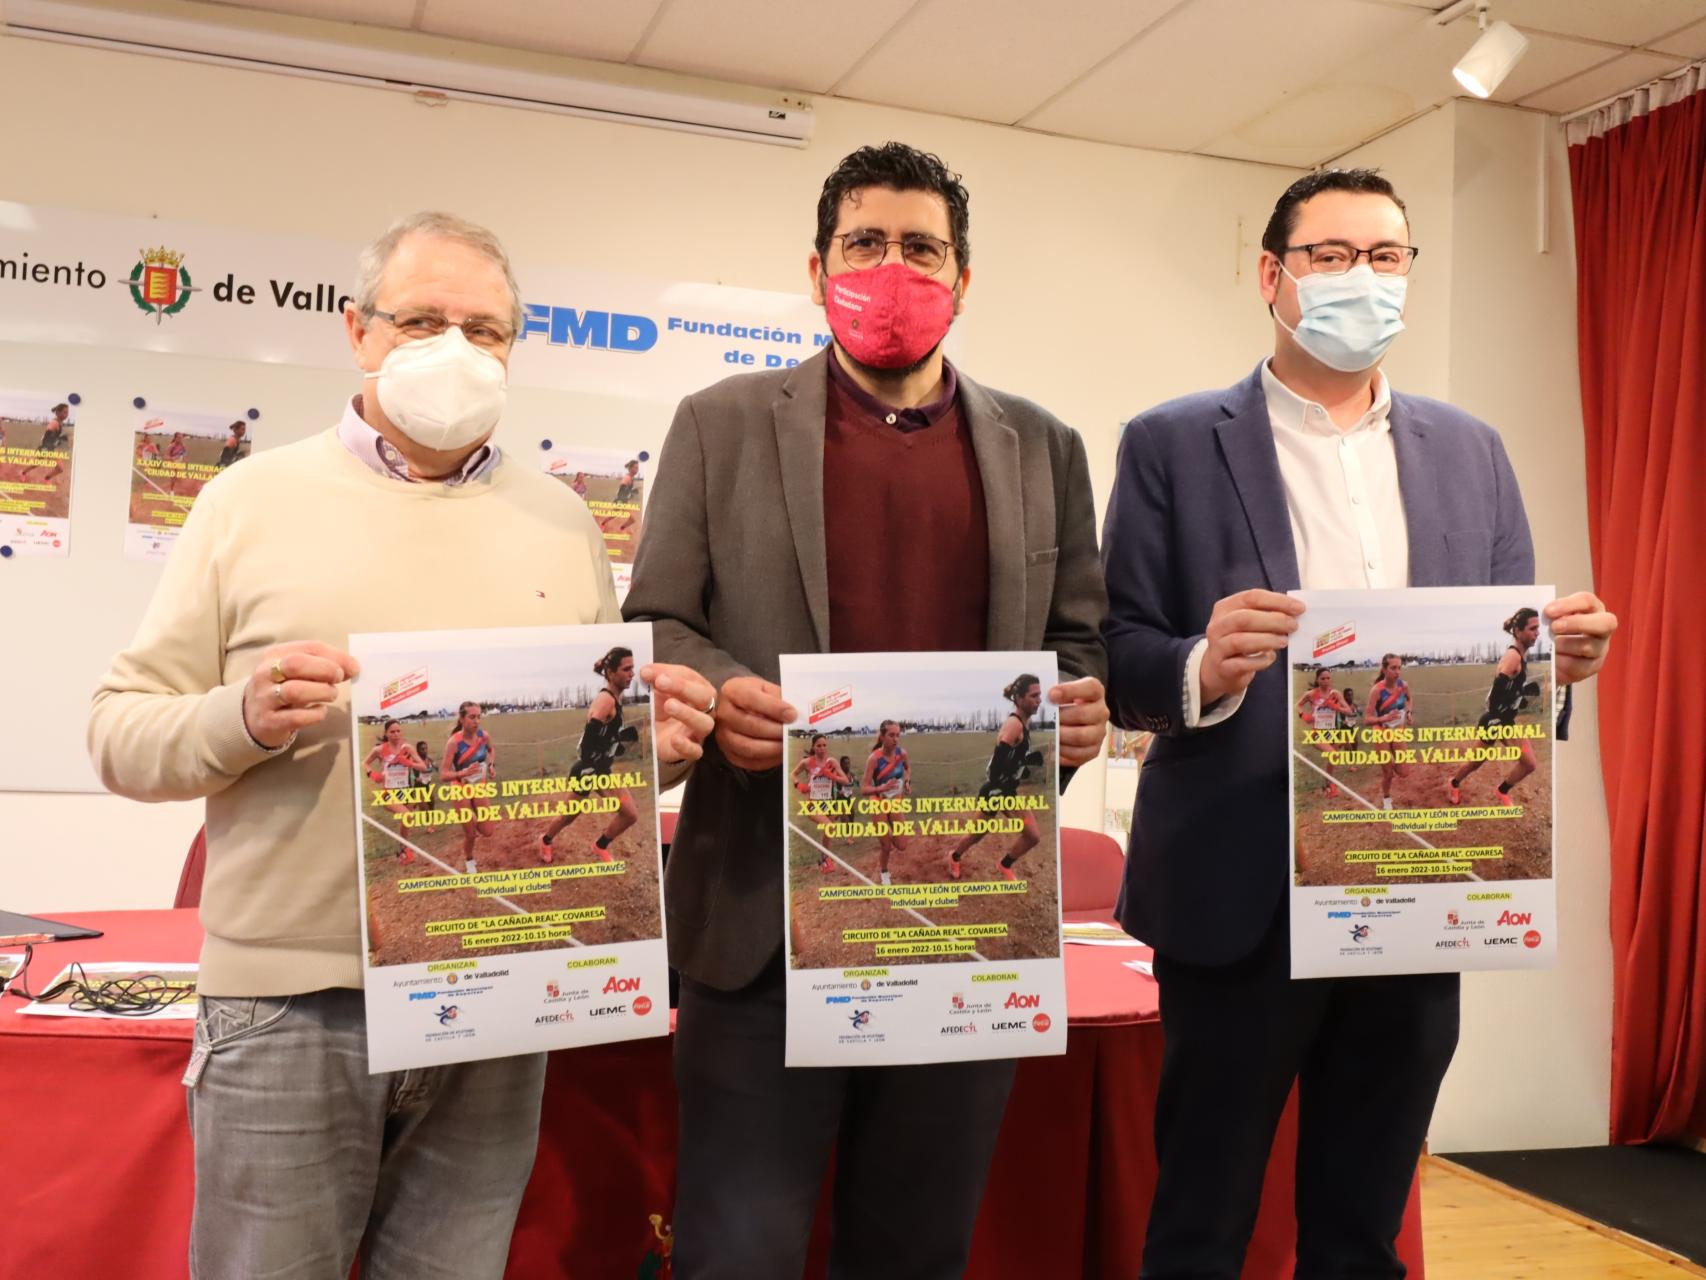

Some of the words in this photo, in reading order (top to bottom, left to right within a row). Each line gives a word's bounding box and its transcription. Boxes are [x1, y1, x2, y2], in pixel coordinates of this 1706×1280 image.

[213, 273, 256, 305] de
[667, 316, 802, 345] Fundación
[723, 350, 755, 366] de
[1302, 727, 1359, 744] XXXIV
[1361, 728, 1414, 743] CROSS
[1418, 724, 1546, 742] INTERNACIONAL
[1395, 749, 1417, 764] DE
[1420, 746, 1521, 763] VALLADOLID
[371, 784, 436, 806] XXXIV
[438, 782, 498, 801] CROSS
[502, 772, 647, 796] INTERNACIONAL
[477, 805, 502, 822] DE
[506, 797, 620, 820] VALLADOLID
[797, 797, 856, 816] XXXIV
[858, 798, 912, 814] CROSS
[916, 795, 1049, 813] INTERNACIONAL
[1323, 813, 1375, 821] CAMPEONATO
[1389, 812, 1421, 820] CASTILLA
[1430, 809, 1448, 818] LEÓN
[1461, 809, 1488, 817] CAMPO
[1497, 807, 1524, 815] TRAVÉS
[892, 820, 915, 836] DE
[919, 817, 1024, 835] VALLADOLID
[1435, 821, 1457, 829] clubes
[1408, 850, 1440, 859] CAÑADA
[1466, 849, 1504, 857] COVARESA
[1452, 864, 1472, 872] horas
[399, 879, 458, 890] CAMPEONATO
[460, 877, 472, 885] DE
[474, 874, 510, 884] CASTILLA
[520, 870, 540, 880] LEÓN
[543, 870, 553, 878] DE
[556, 867, 586, 877] CAMPO
[596, 863, 625, 873] TRAVÉS
[526, 882, 551, 891] clubes
[820, 889, 873, 897] CAMPEONATO
[876, 888, 886, 896] DE
[887, 887, 921, 895] CASTILLA
[930, 884, 949, 894] LEÓN
[951, 885, 960, 893] DE
[962, 884, 990, 892] CAMPO
[1000, 882, 1027, 890] TRAVÉS
[935, 897, 958, 905] clubes
[425, 922, 465, 933] CIRCUITO
[468, 921, 478, 929] DE
[498, 916, 533, 926] CAÑADA
[562, 909, 605, 920] COVARESA
[463, 938, 473, 946] 16
[548, 930, 571, 938] horas
[843, 932, 879, 940] CIRCUITO
[908, 929, 941, 937] CAÑADA
[968, 926, 1007, 934] COVARESA
[955, 943, 976, 951] horas
[1484, 937, 1518, 945] UEMC
[590, 1005, 626, 1016] UEMC
[992, 1021, 1027, 1030] UEMC
